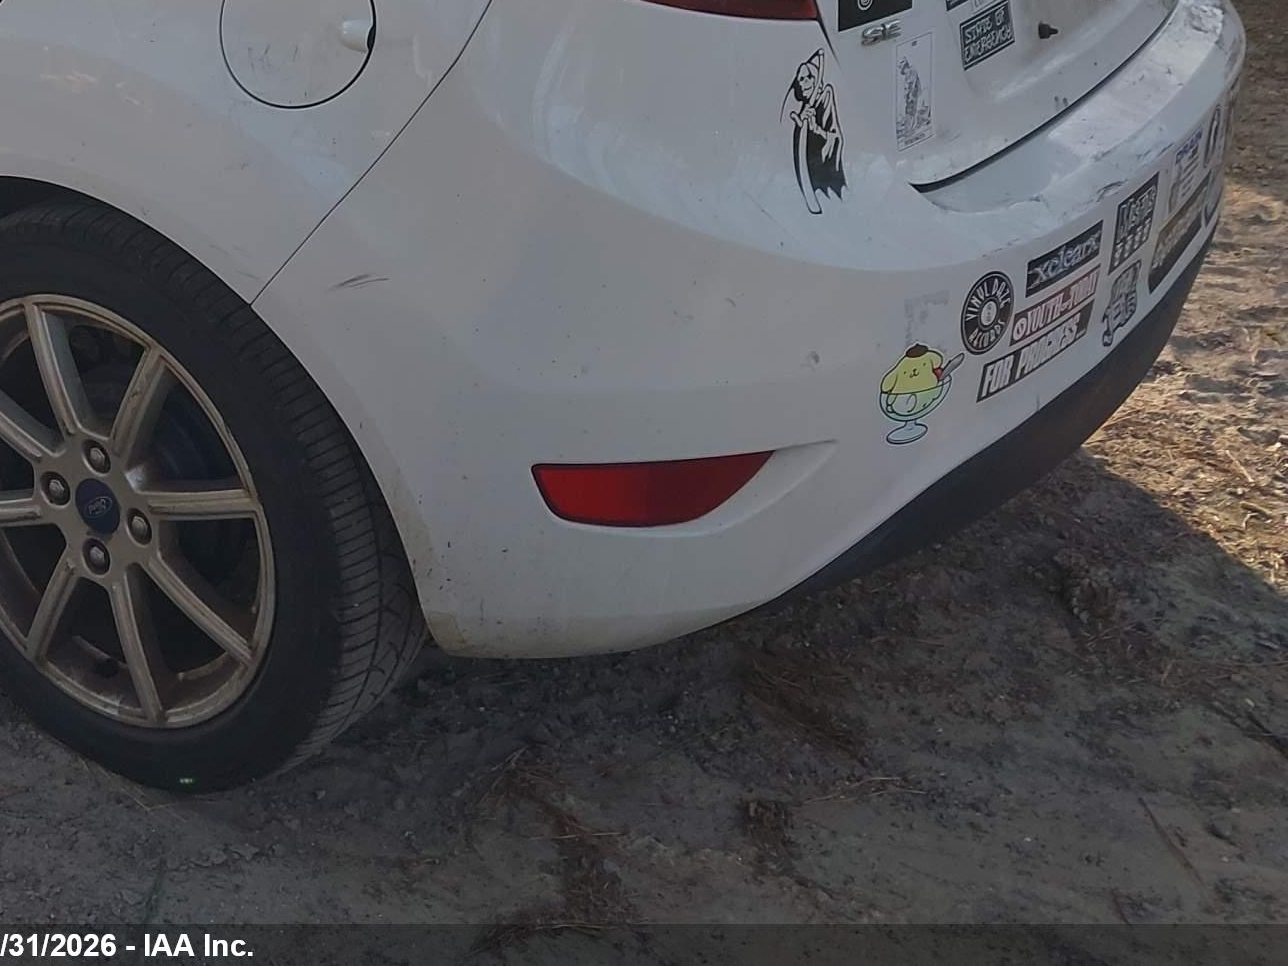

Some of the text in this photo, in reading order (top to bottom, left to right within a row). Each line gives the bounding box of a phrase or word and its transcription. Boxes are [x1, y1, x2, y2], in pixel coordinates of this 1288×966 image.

[862, 20, 902, 47] SE
[964, 281, 989, 322] VINYL
[981, 354, 1015, 398] FOR
